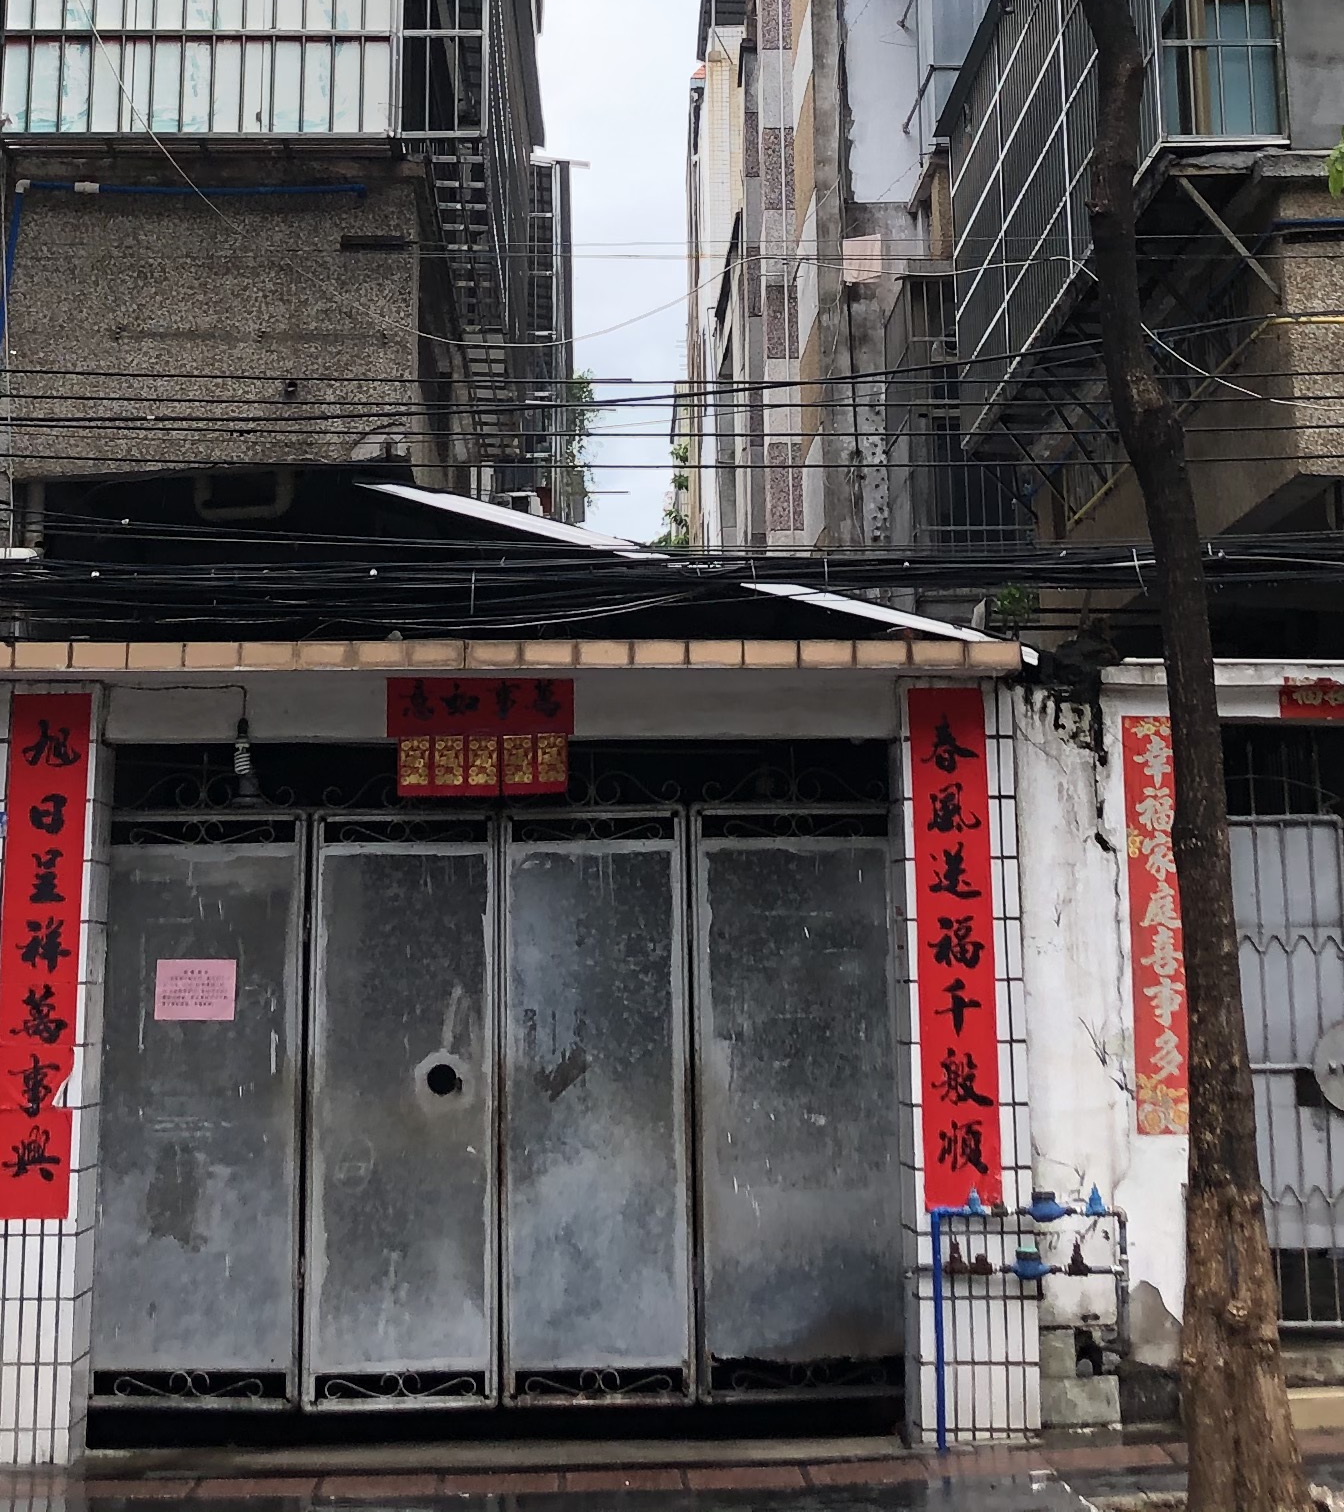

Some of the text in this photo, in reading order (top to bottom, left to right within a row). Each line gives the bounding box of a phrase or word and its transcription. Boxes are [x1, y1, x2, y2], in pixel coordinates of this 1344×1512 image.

[1134, 734, 1184, 1081] 幸福家庭喜事多
